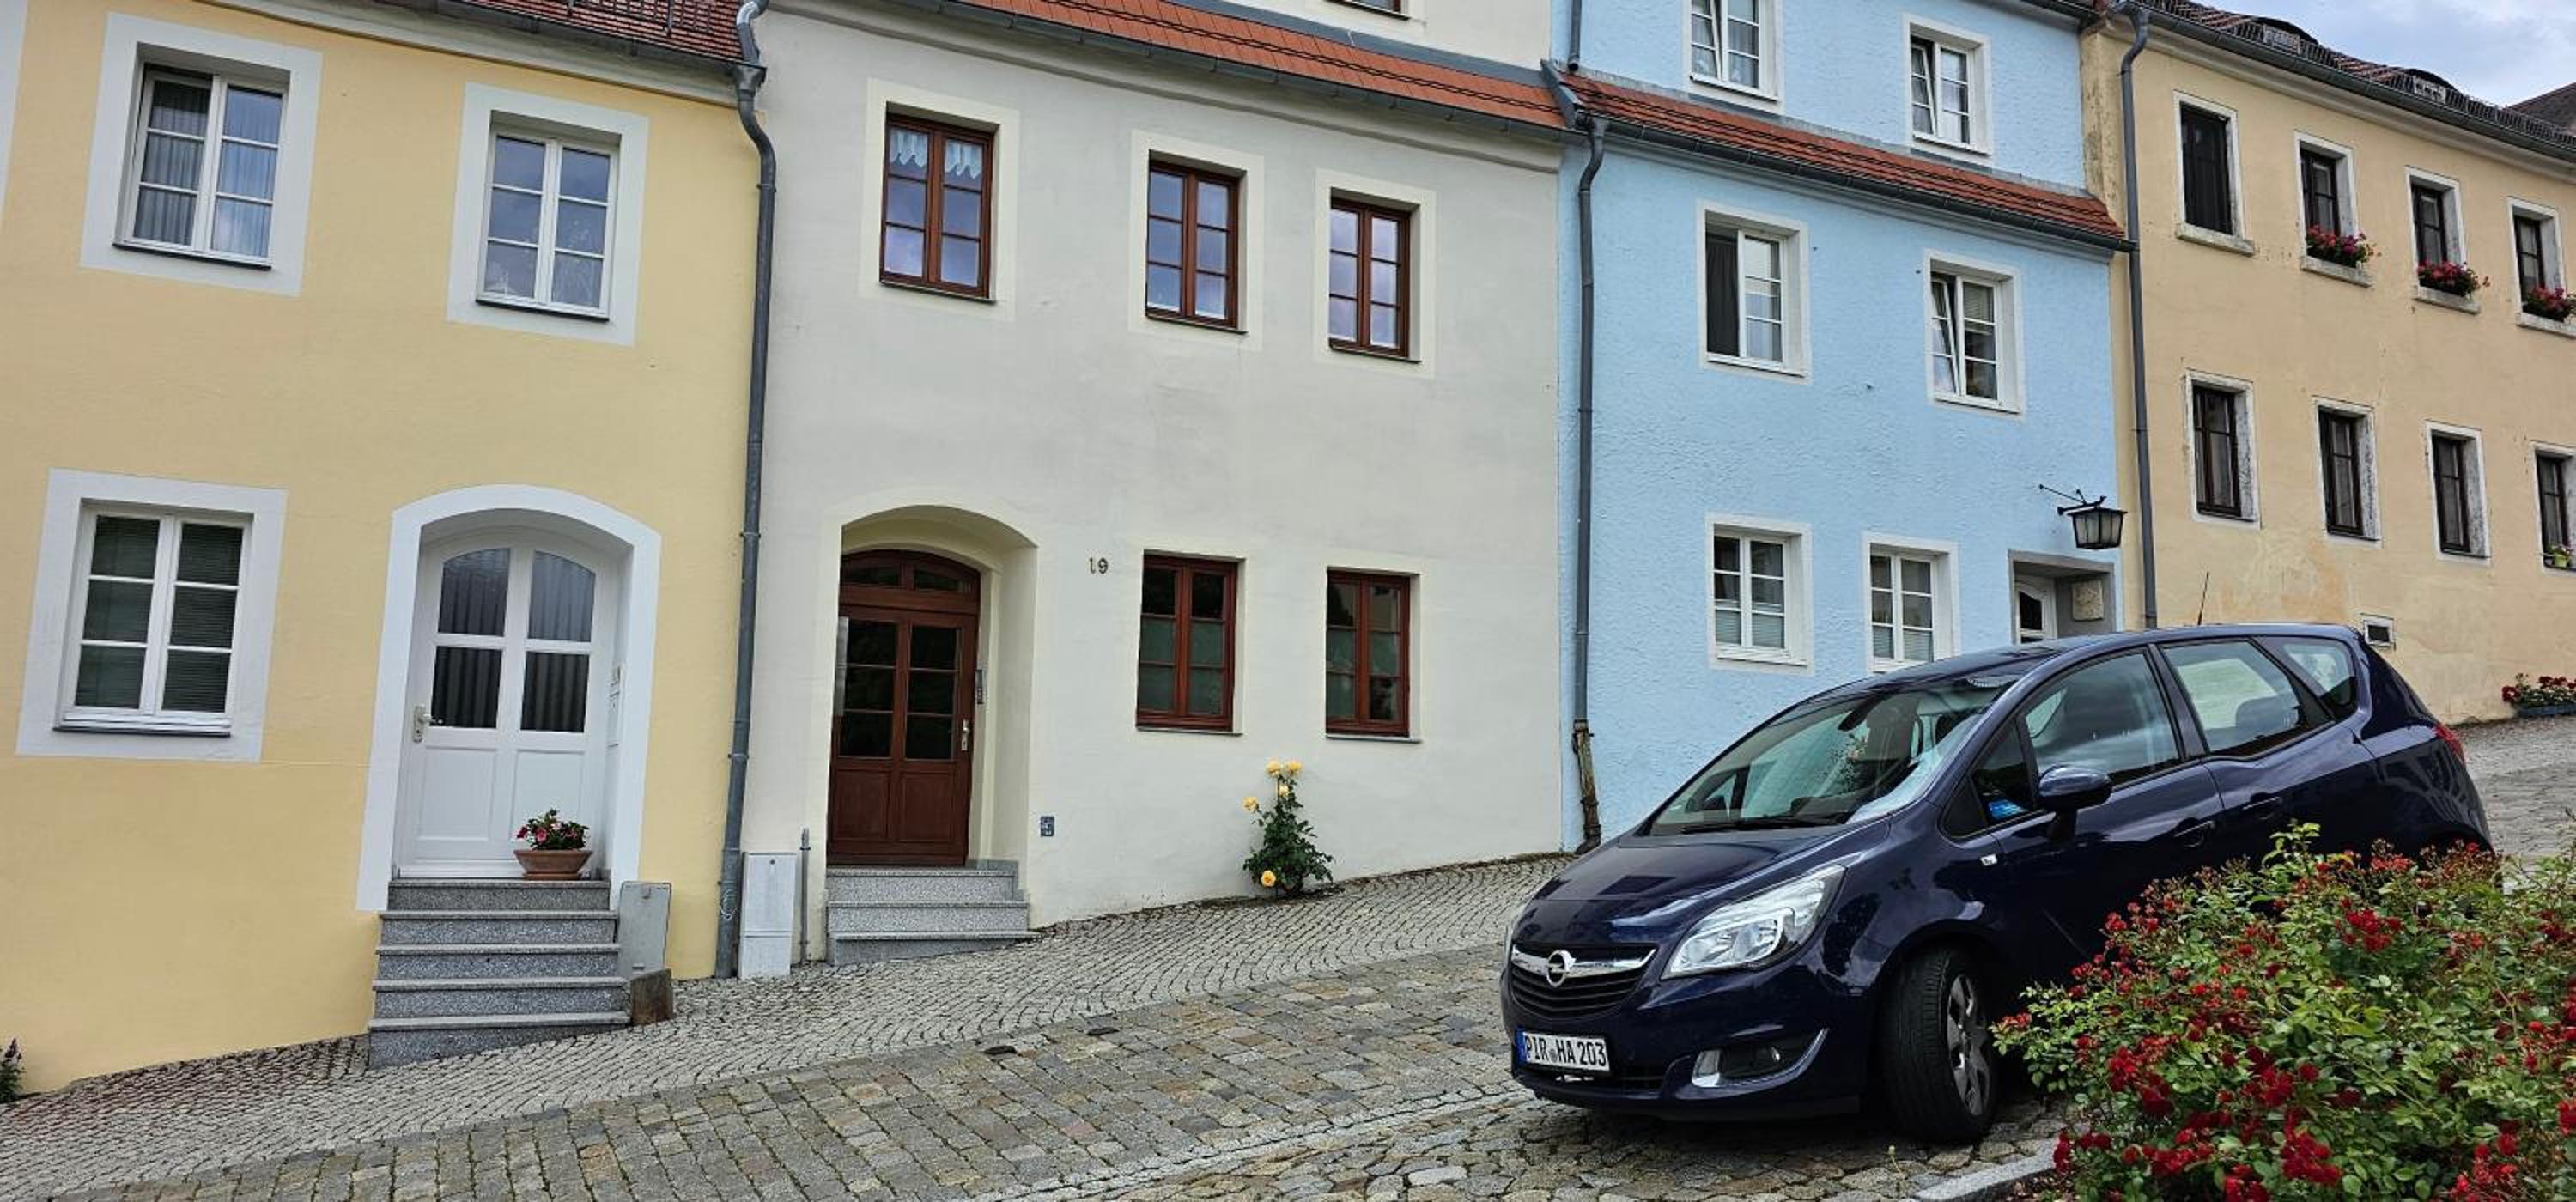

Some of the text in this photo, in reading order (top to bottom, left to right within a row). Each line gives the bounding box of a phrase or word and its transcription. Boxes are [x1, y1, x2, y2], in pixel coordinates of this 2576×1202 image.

[1089, 557, 1109, 574] 19
[1524, 1035, 1607, 1067] PIR HA 203
